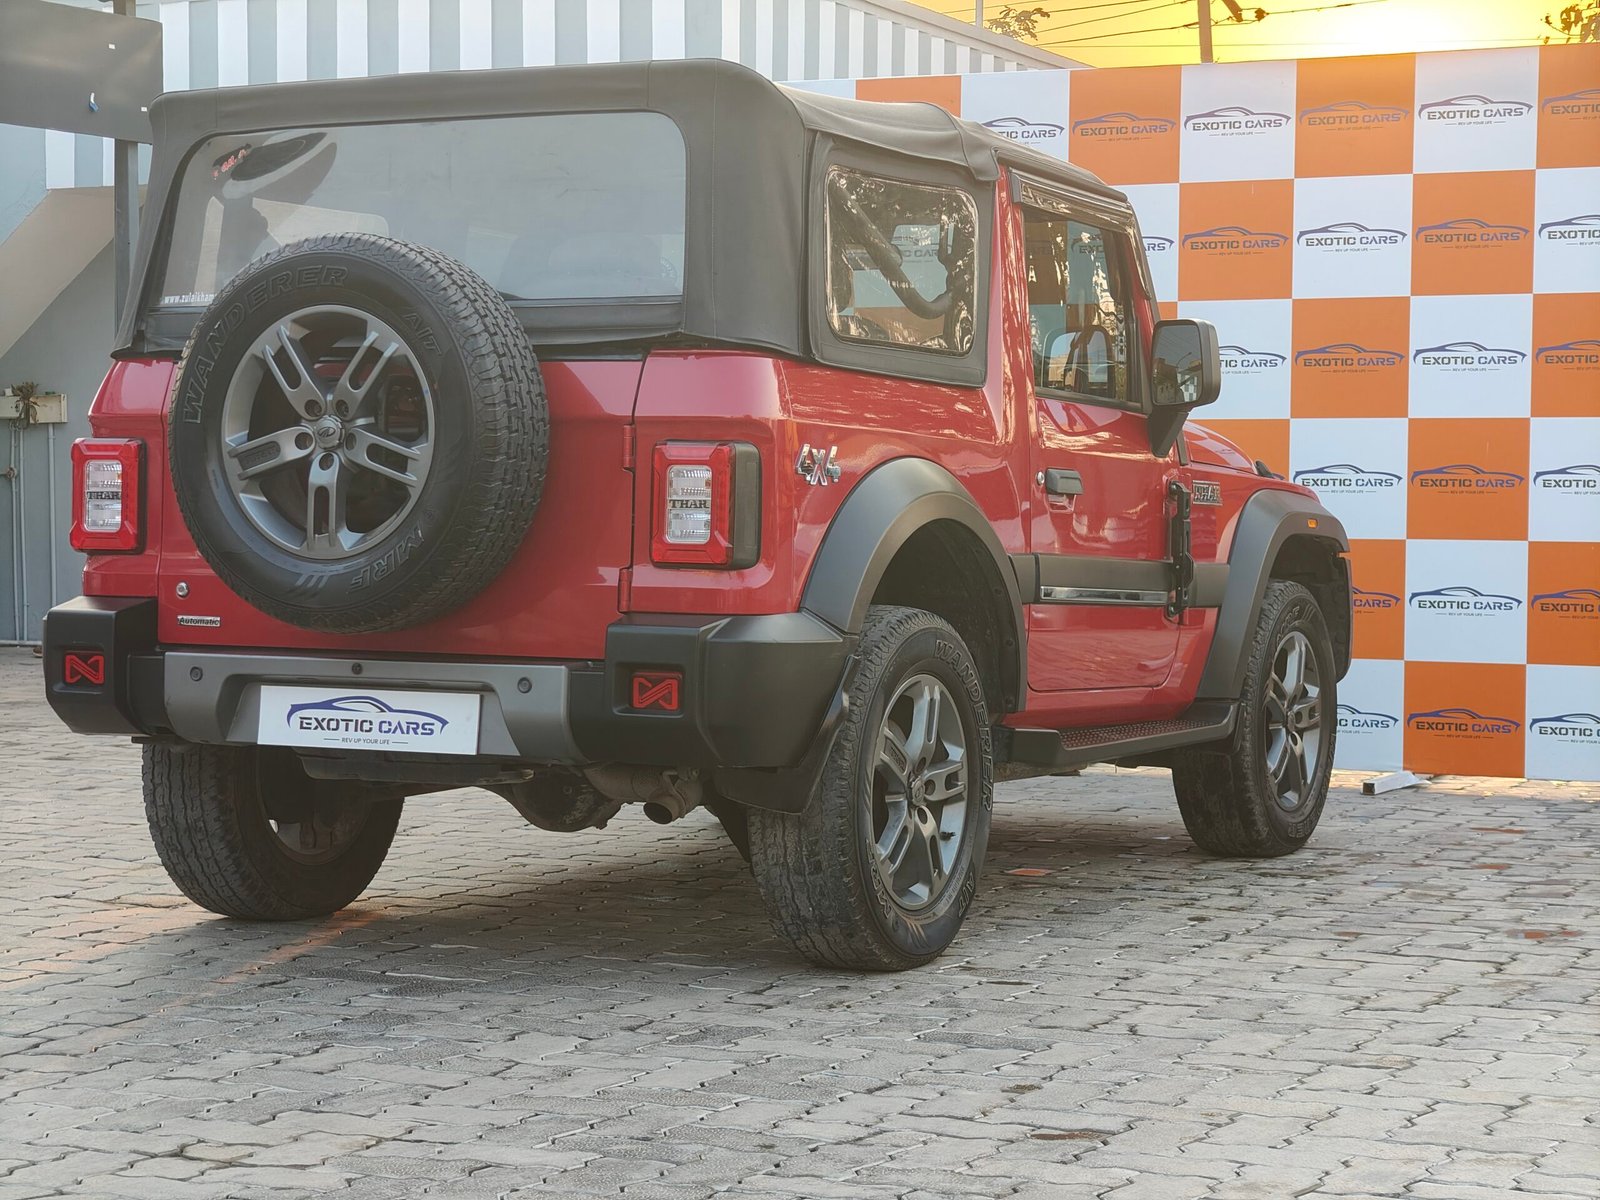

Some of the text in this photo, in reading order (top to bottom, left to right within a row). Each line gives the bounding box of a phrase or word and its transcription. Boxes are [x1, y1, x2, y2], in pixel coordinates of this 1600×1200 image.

[1427, 107, 1523, 120] EXOTIC CARS
[1308, 113, 1401, 126] EXOTIC CARS
[1192, 119, 1282, 131] EXOTIC CARS
[1021, 129, 1056, 138] CARS
[1080, 124, 1167, 137] EXOTIC CARS
[1424, 232, 1520, 243] EXOTIC CARS
[1548, 230, 1600, 240] EXOTIC
[1190, 239, 1280, 250] EXOTIC CARS
[1305, 235, 1398, 246] EXOTIC CARS
[184, 265, 348, 424] WANDERER
[1241, 359, 1278, 367] CARS
[1303, 357, 1395, 367] EXOTIC CARS
[1422, 355, 1518, 365] EXOTIC CARS
[1545, 355, 1599, 364] EXOTIC
[1301, 478, 1394, 487] EXOTIC CARS
[1420, 478, 1515, 488] EXOTIC CARS
[1542, 479, 1596, 488] EXOTIC
[87, 491, 121, 500] THAR
[669, 499, 709, 509] THAR
[351, 522, 424, 591] MRF
[1353, 599, 1392, 608] CARS
[1417, 600, 1513, 611] EXOTIC CARS
[1540, 603, 1594, 613] EXOTIC
[178, 616, 220, 626] Automatic
[299, 716, 435, 736] EXOTIC CARS
[935, 639, 994, 812] WANDERER
[1352, 719, 1390, 729] CARS
[1416, 721, 1512, 734] EXOTIC CARS
[1539, 726, 1593, 737] EXOTIC
